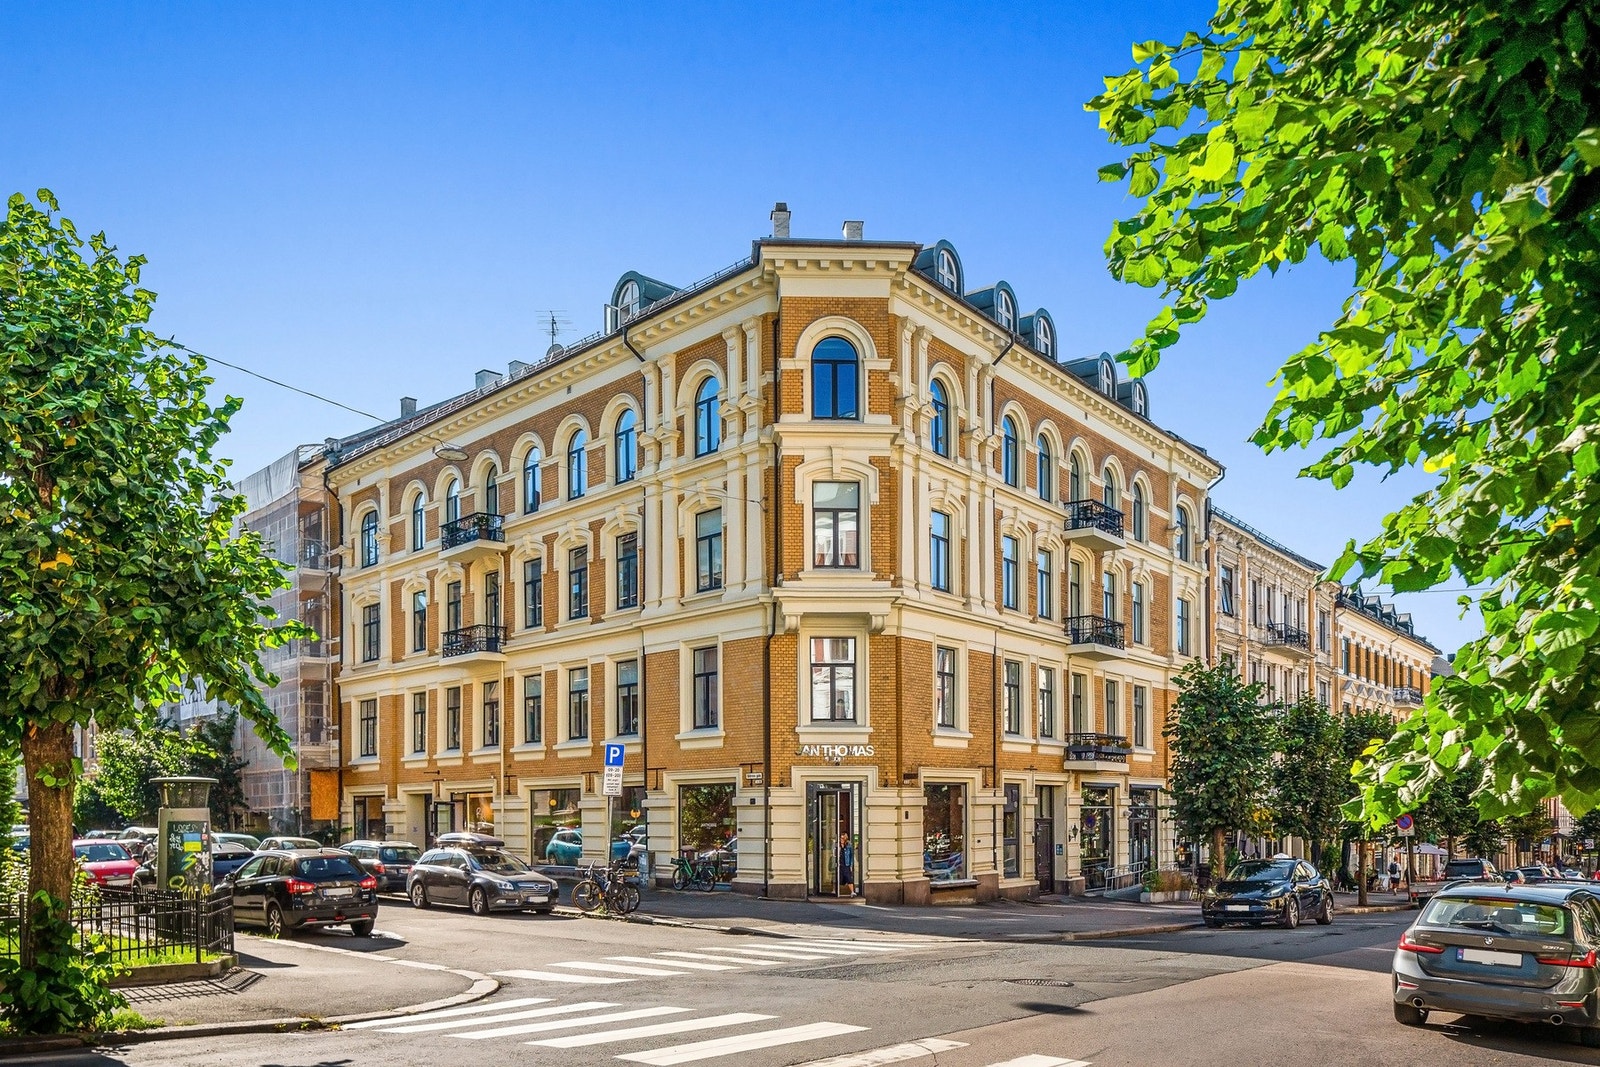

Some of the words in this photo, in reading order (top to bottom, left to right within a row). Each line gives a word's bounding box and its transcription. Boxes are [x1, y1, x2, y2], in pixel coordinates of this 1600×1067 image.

[609, 746, 620, 764] P
[795, 745, 820, 756] JAN
[821, 745, 875, 756] THOMAS
